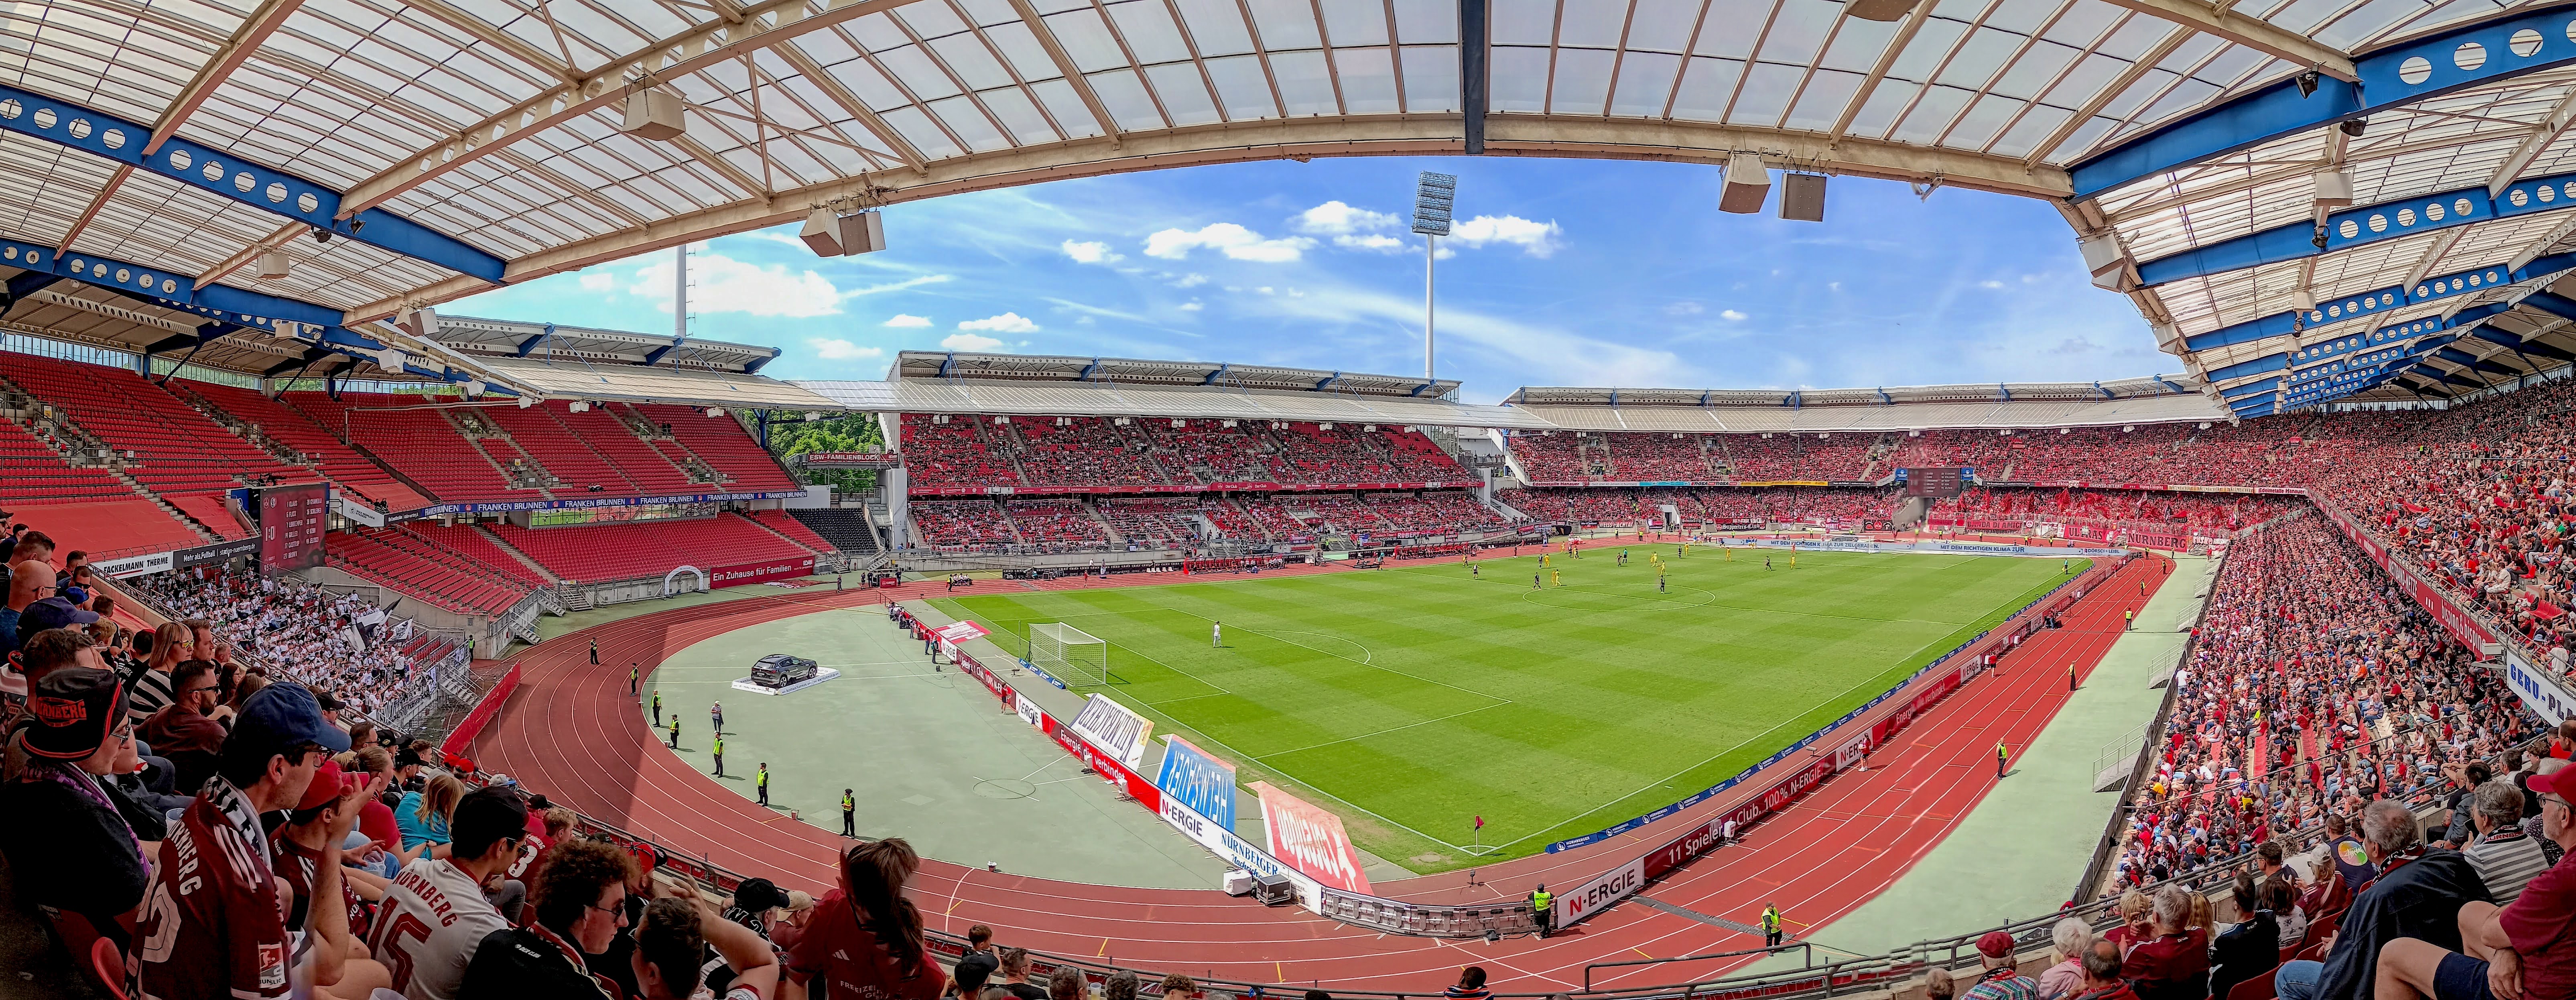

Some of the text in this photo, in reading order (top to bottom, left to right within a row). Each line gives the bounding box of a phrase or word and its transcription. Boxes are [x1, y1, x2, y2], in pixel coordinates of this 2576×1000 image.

[478, 502, 547, 511] FRANKEN BRUNNEN
[104, 557, 168, 573] FACKELMANN THERME
[183, 554, 194, 562] Mehr
[713, 564, 792, 581] Ein Zuhause für Familien
[1060, 729, 1083, 756] Energie,
[1095, 755, 1125, 780] verbindet
[1166, 750, 1229, 829] HELMSAUER
[1669, 845, 1680, 864] 11
[1737, 803, 1762, 826] Club.
[1764, 787, 1788, 810] 100%
[1791, 765, 1823, 795] N-ERGIE.
[392, 870, 458, 927] NÜRNBERG
[367, 895, 433, 994] 15
[528, 951, 542, 959] CLUB
